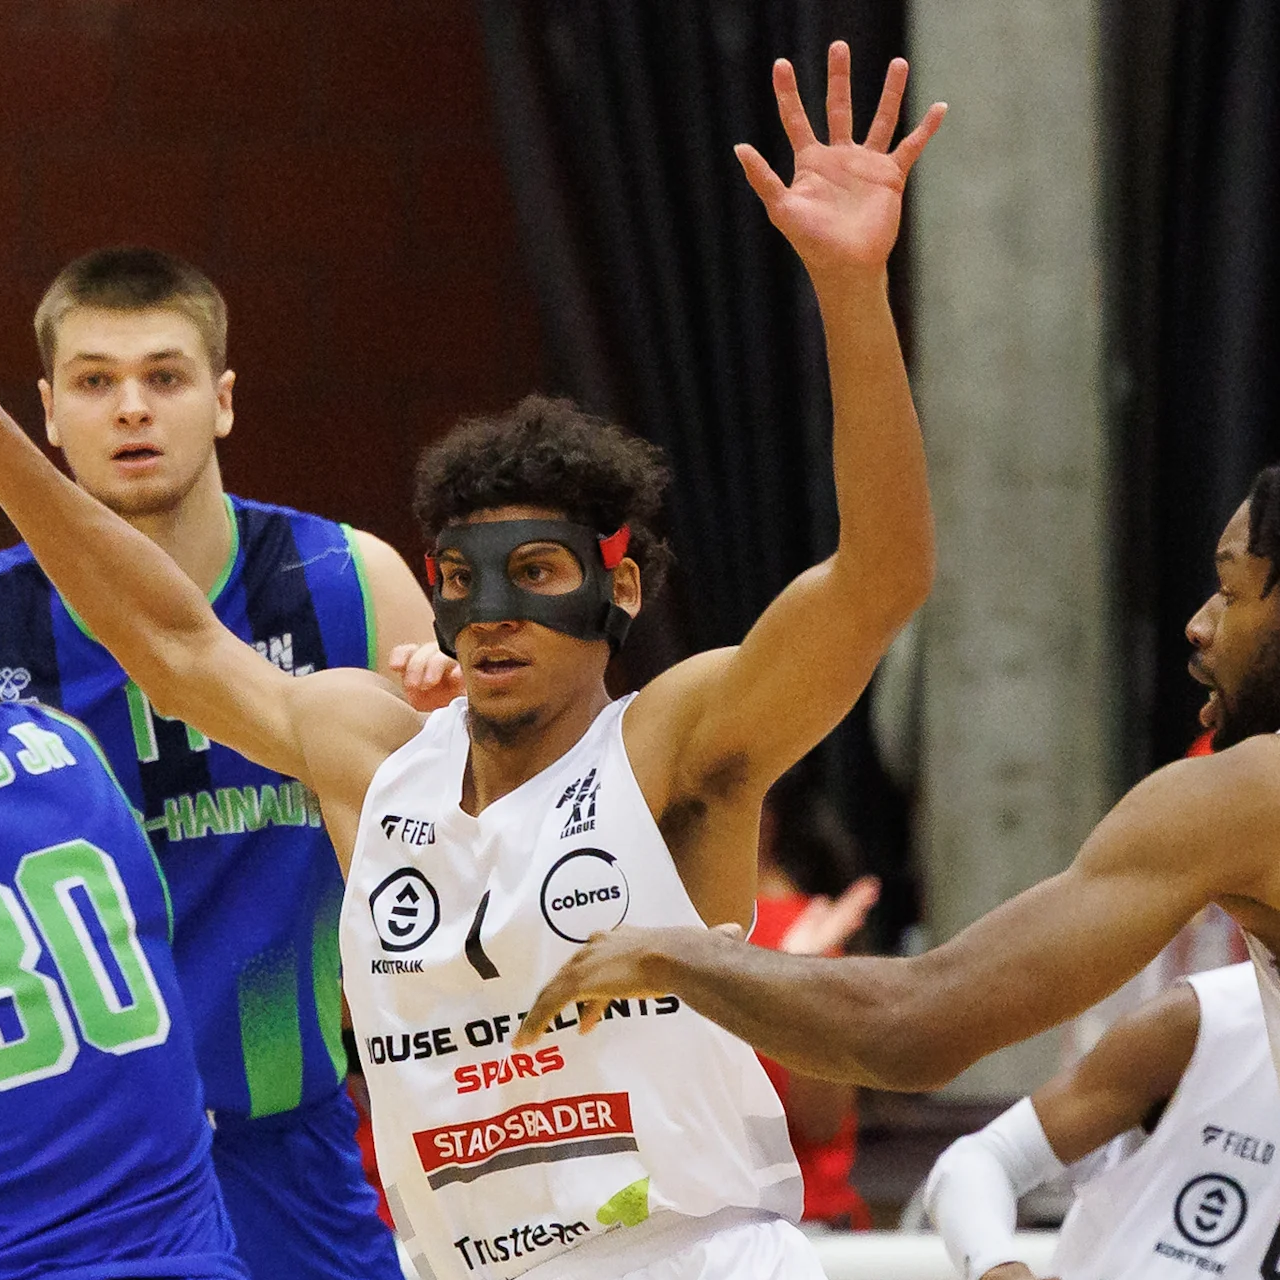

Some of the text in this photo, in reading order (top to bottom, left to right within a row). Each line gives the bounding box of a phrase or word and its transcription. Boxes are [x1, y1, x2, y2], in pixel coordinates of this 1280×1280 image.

[560, 819, 596, 840] LEAGUE
[551, 884, 621, 911] cobras
[464, 1015, 511, 1048] OF
[453, 1045, 565, 1095] SPURS
[433, 1099, 617, 1159] STADSBADER
